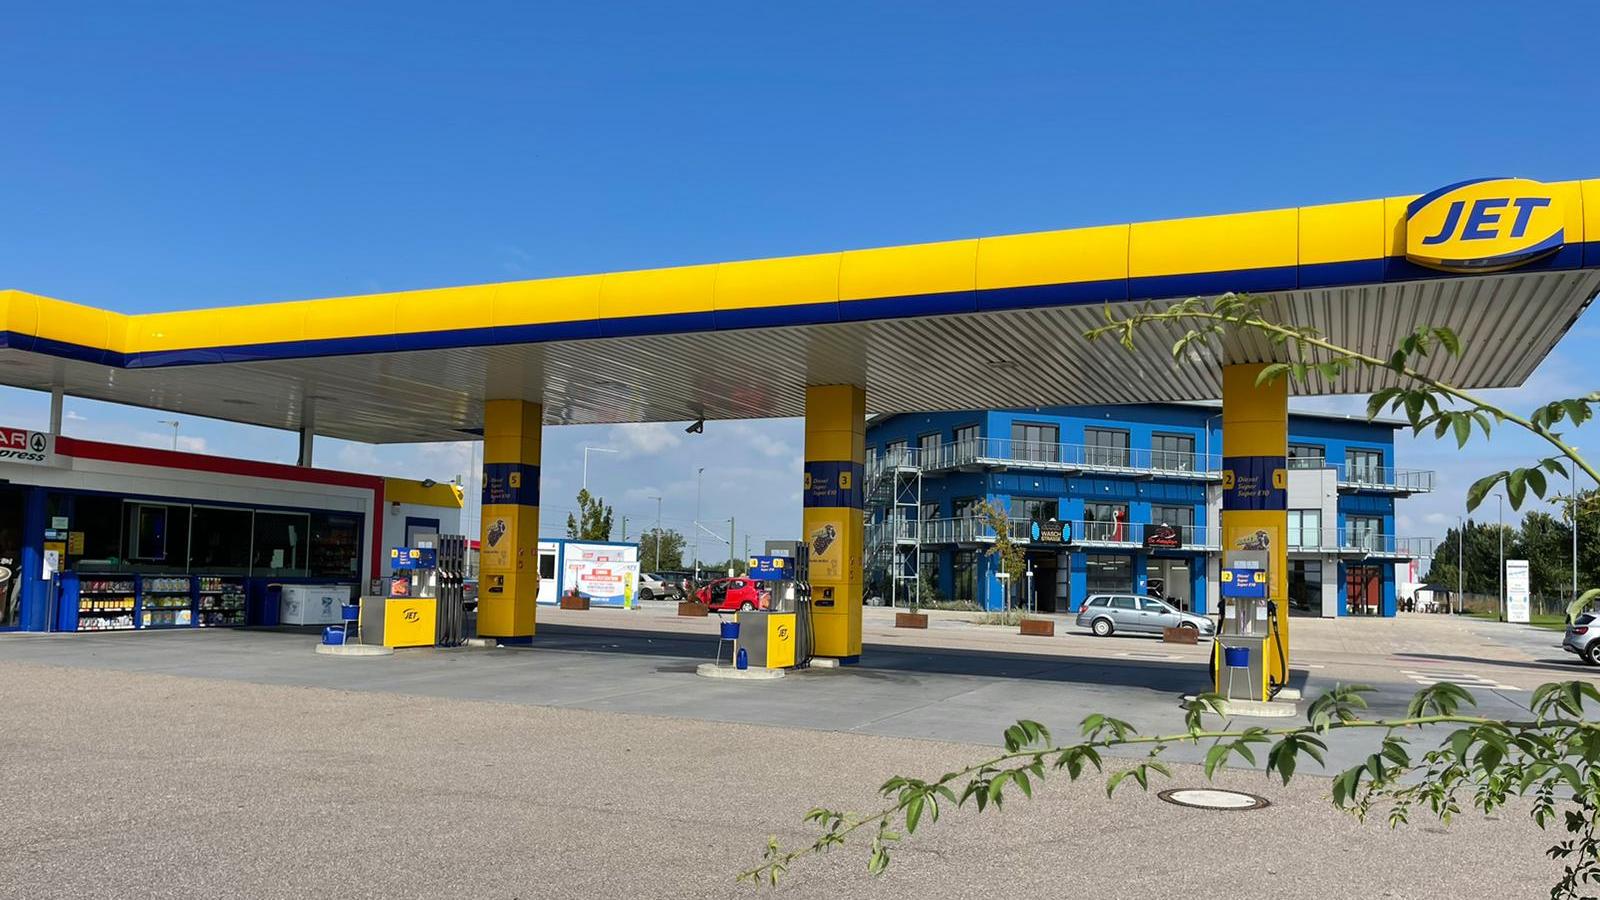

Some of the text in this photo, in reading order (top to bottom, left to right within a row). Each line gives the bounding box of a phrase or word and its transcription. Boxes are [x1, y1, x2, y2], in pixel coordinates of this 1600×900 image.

[1422, 198, 1551, 245] JET
[841, 475, 848, 485] 3
[1226, 474, 1232, 485] 2
